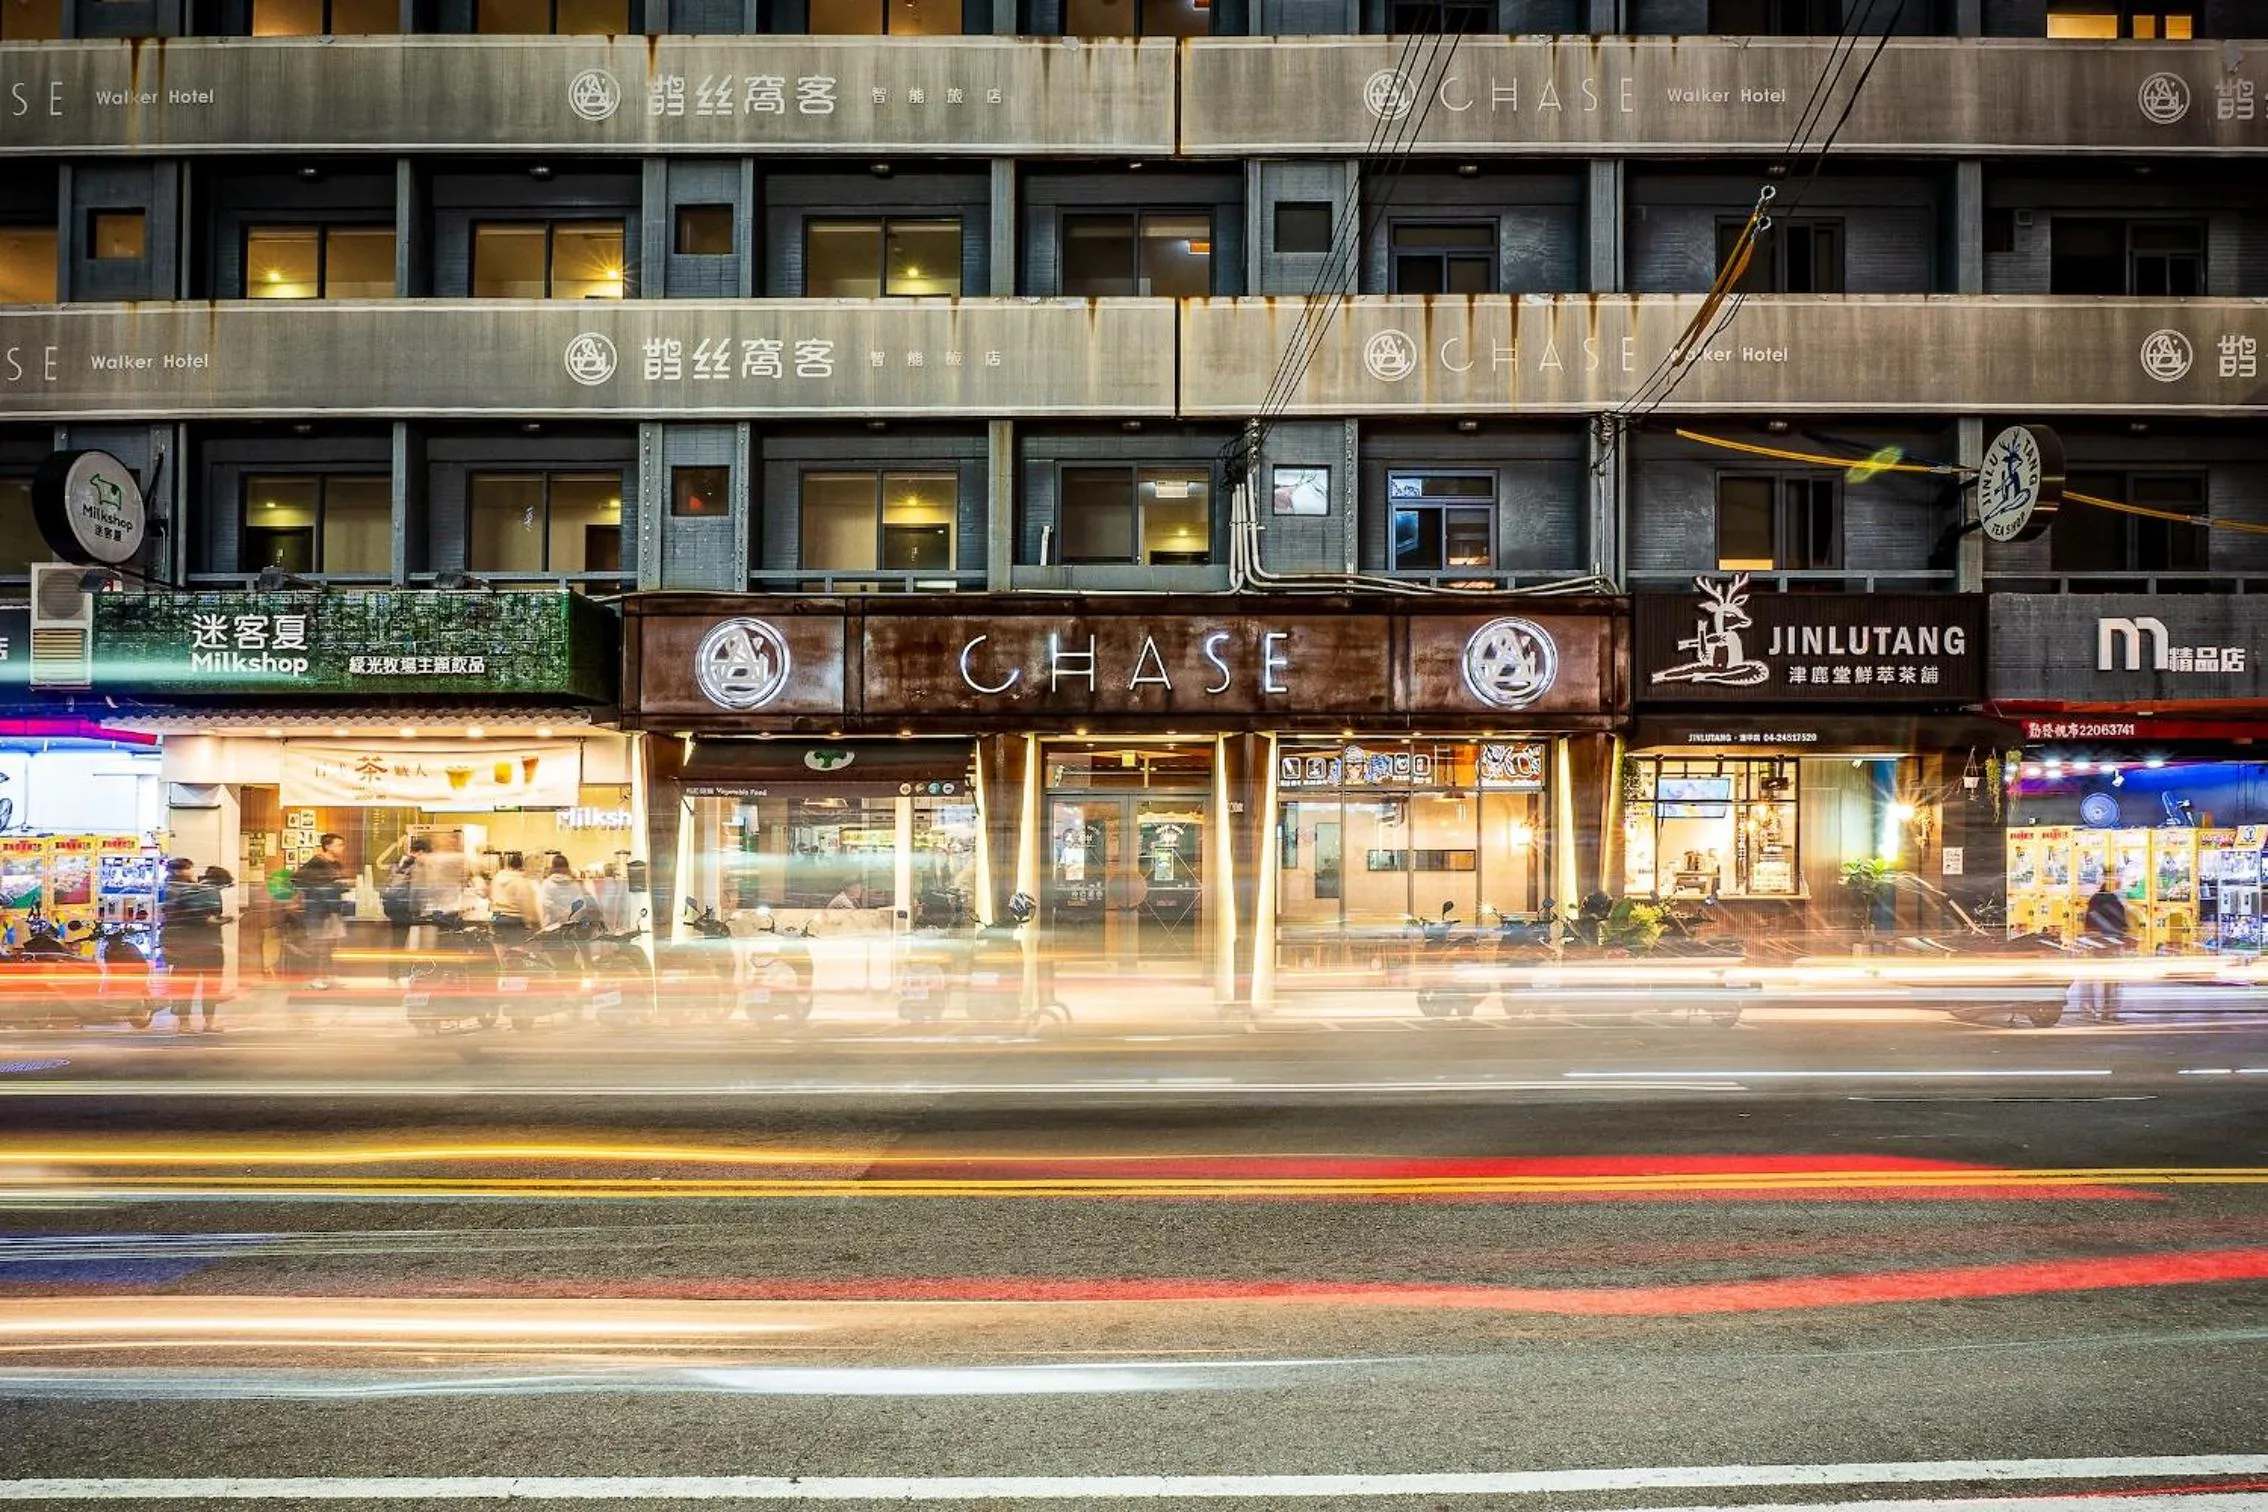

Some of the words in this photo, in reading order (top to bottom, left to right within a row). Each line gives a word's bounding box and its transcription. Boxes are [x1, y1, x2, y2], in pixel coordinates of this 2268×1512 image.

[96, 89, 158, 105] Walker
[168, 88, 215, 104] Hotel
[1440, 76, 1634, 113] CHASE
[1667, 87, 1731, 103] Walker
[1740, 87, 1787, 103] Hotel
[91, 354, 153, 371] Walker
[163, 353, 209, 369] Hotel
[1440, 337, 1636, 373] CHASE
[1742, 346, 1789, 362] Hotel
[82, 503, 134, 533] Milkshop
[191, 613, 308, 651] 迷客夏
[1768, 626, 1966, 656] JINLUTANG
[191, 651, 309, 677] Milkshop
[960, 631, 1289, 694] CHASE
[1688, 733, 1732, 743] JINLUTANG
